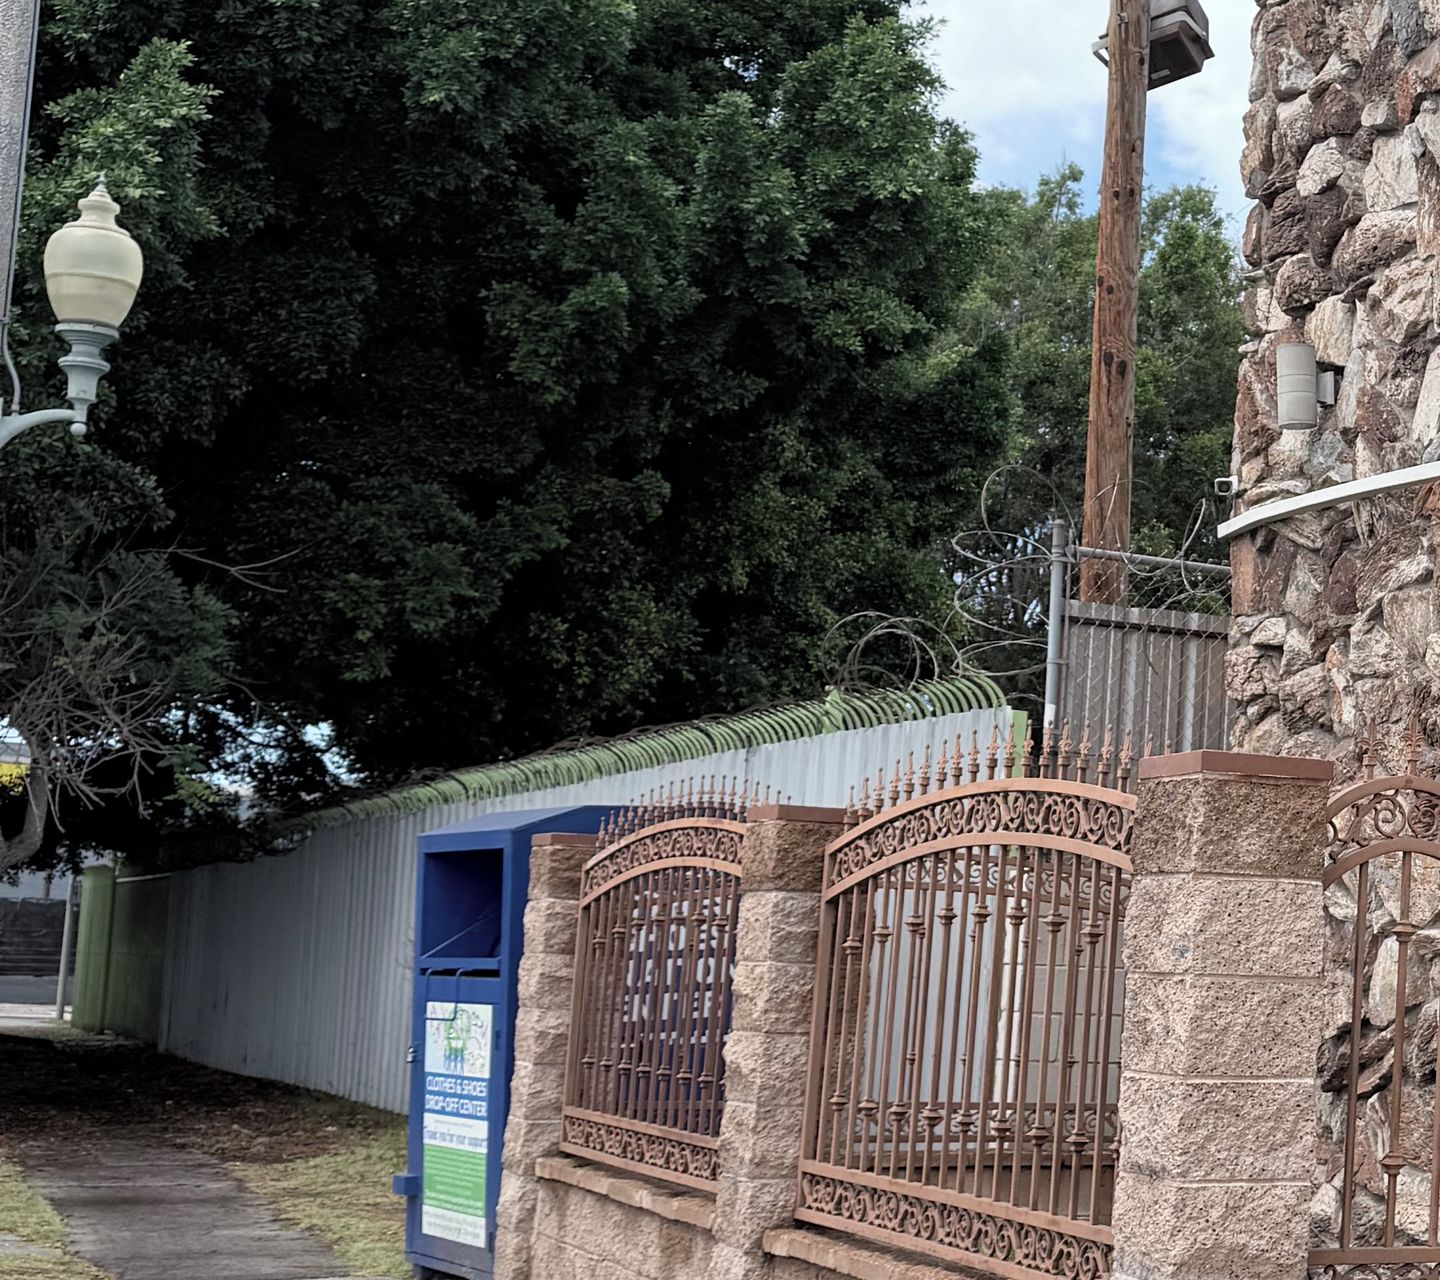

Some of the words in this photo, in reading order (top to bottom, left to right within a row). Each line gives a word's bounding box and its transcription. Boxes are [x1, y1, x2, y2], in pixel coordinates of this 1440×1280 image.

[426, 1076, 456, 1093] CLOTHES
[462, 1080, 488, 1097] SHOES
[459, 1099, 488, 1117] CENTER
